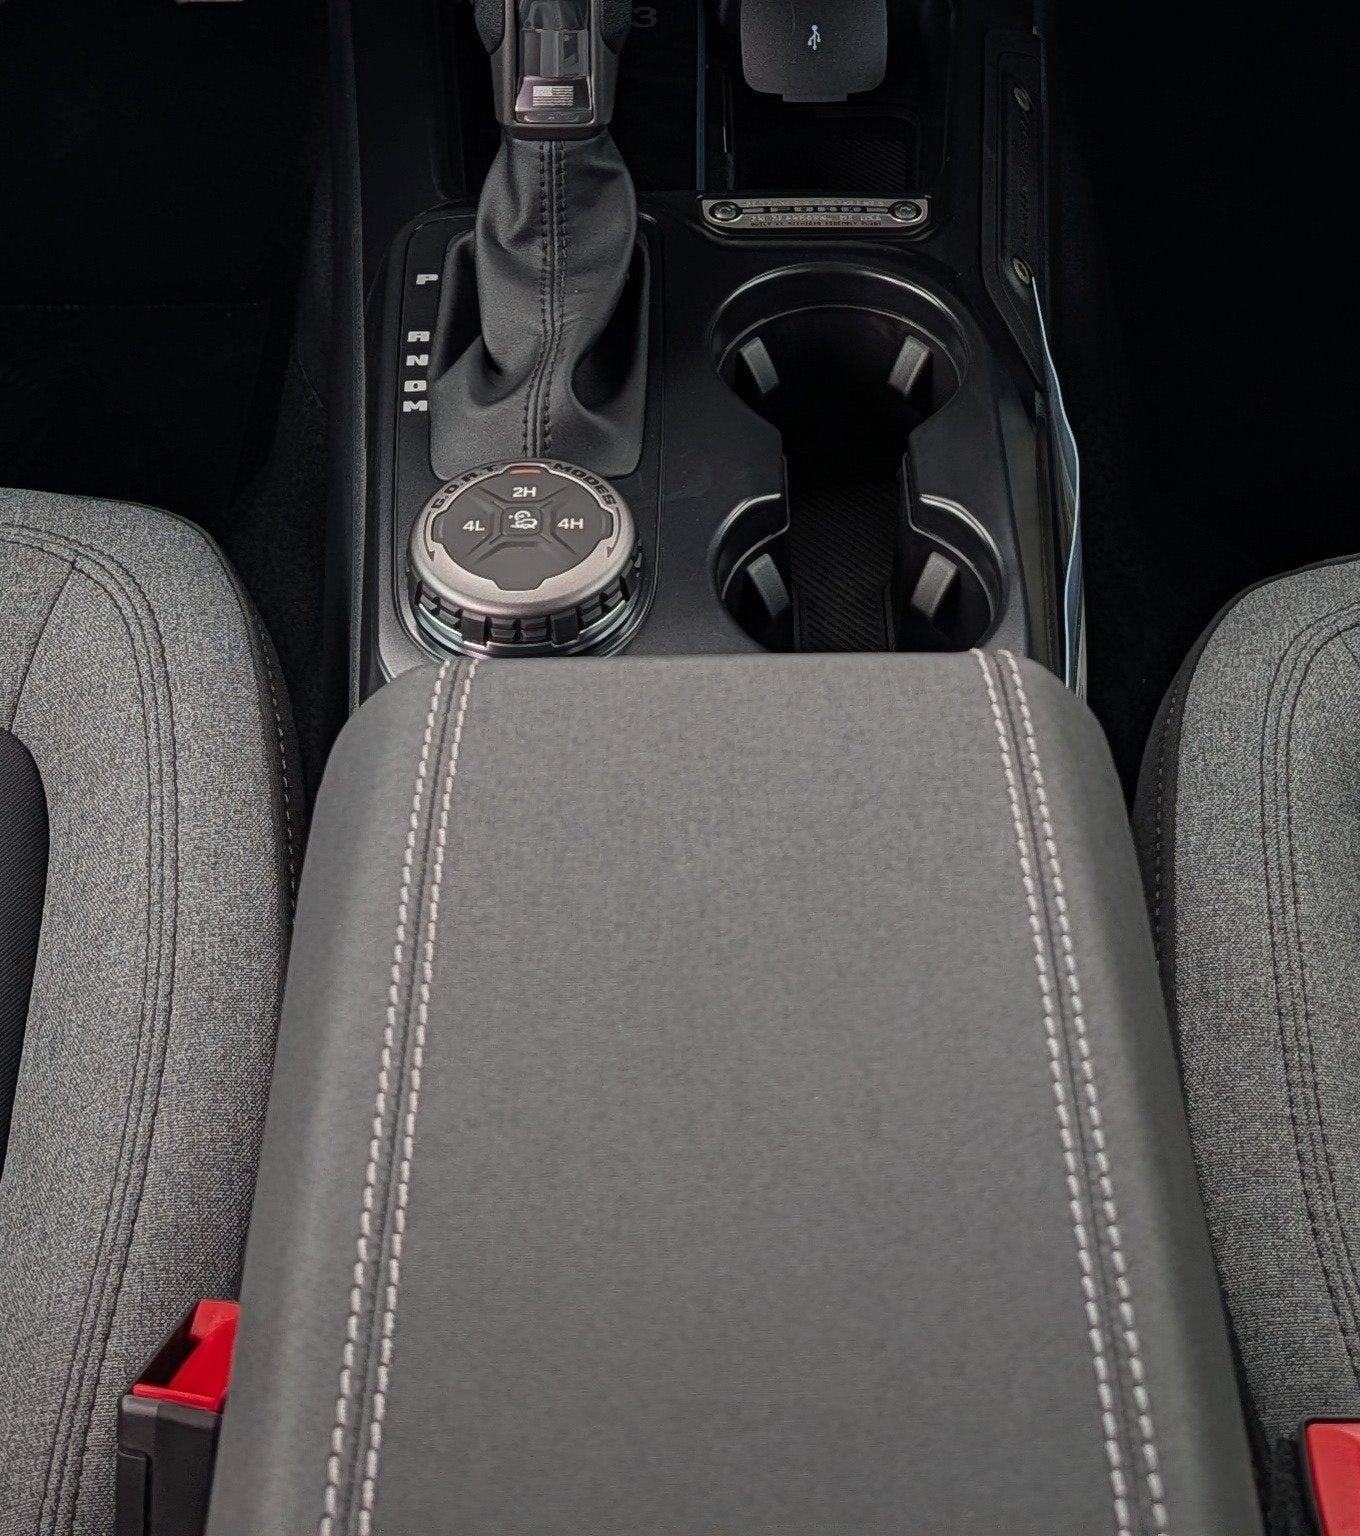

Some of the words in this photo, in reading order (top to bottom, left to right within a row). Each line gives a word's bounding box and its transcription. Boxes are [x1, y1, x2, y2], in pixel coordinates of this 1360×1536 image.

[415, 273, 439, 285] P
[406, 330, 431, 343] R
[405, 353, 429, 366] N
[403, 379, 427, 392] D
[402, 399, 428, 413] M
[553, 463, 617, 506] MODES
[512, 486, 537, 498] 2H
[462, 519, 486, 532] 4L
[557, 518, 584, 530] 4H
